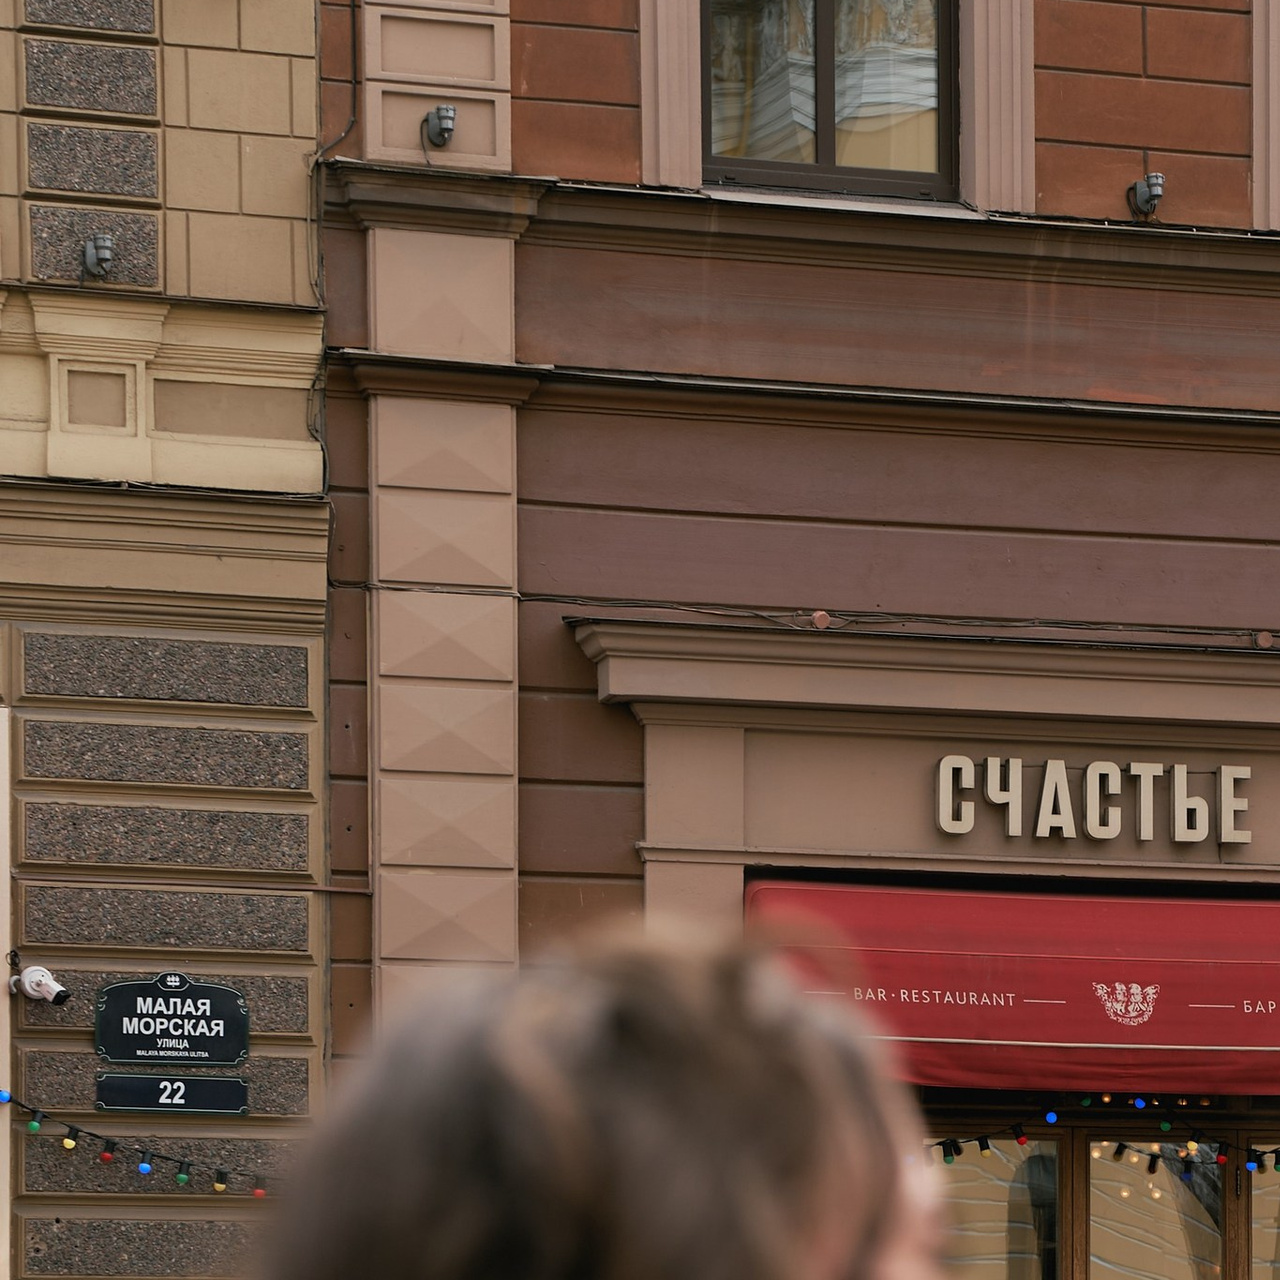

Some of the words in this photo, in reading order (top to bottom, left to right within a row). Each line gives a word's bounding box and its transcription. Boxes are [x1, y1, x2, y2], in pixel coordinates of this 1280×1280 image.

[936, 754, 1252, 844] СЧАСТЬЕ
[136, 996, 211, 1016] МАЛАЯ
[122, 1017, 225, 1037] МОРСКАЯ
[156, 1038, 190, 1050] УЛИЦА
[158, 1081, 186, 1104] 22
